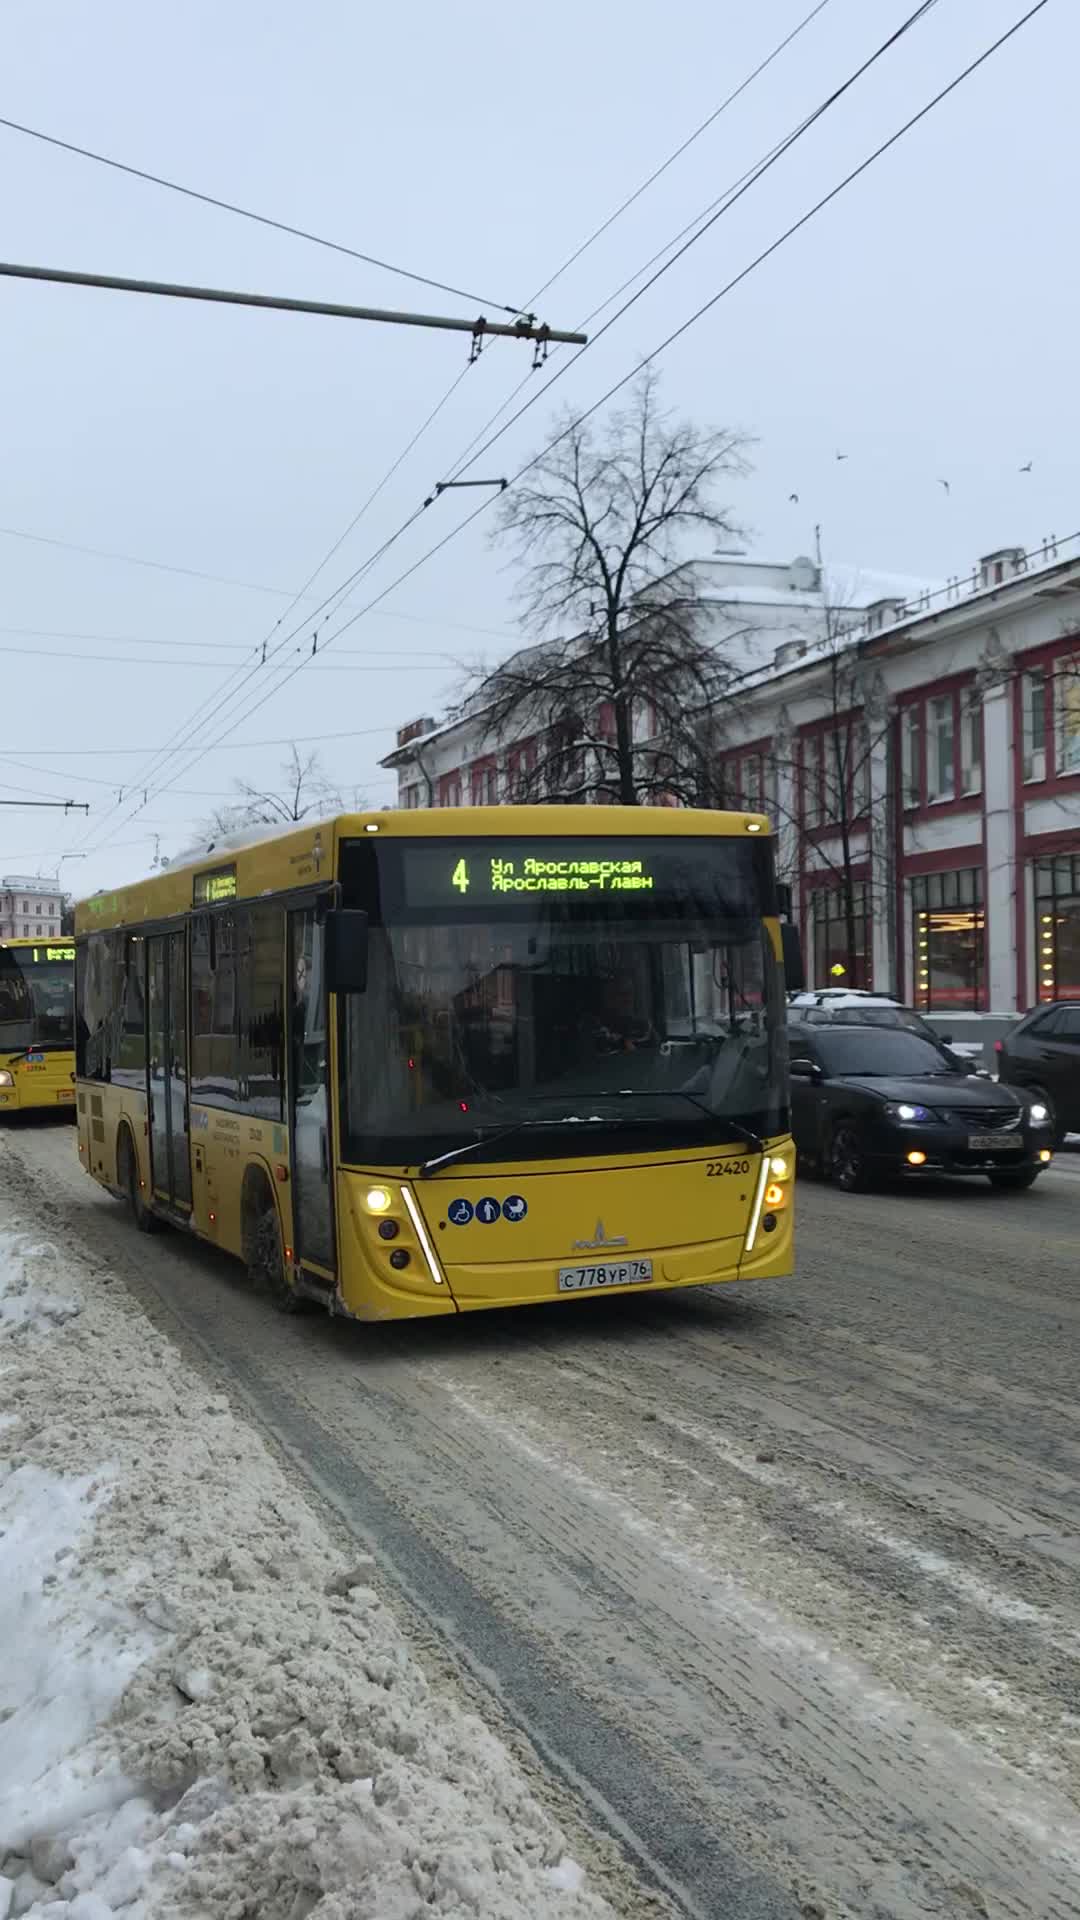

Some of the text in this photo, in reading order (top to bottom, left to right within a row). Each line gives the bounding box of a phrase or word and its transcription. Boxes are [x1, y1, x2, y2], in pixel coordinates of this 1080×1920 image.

[452, 858, 470, 893] 4
[490, 858, 642, 876] Ул Ярославская
[491, 874, 653, 892] Ярославль-Главн
[706, 1160, 750, 1176] 22420
